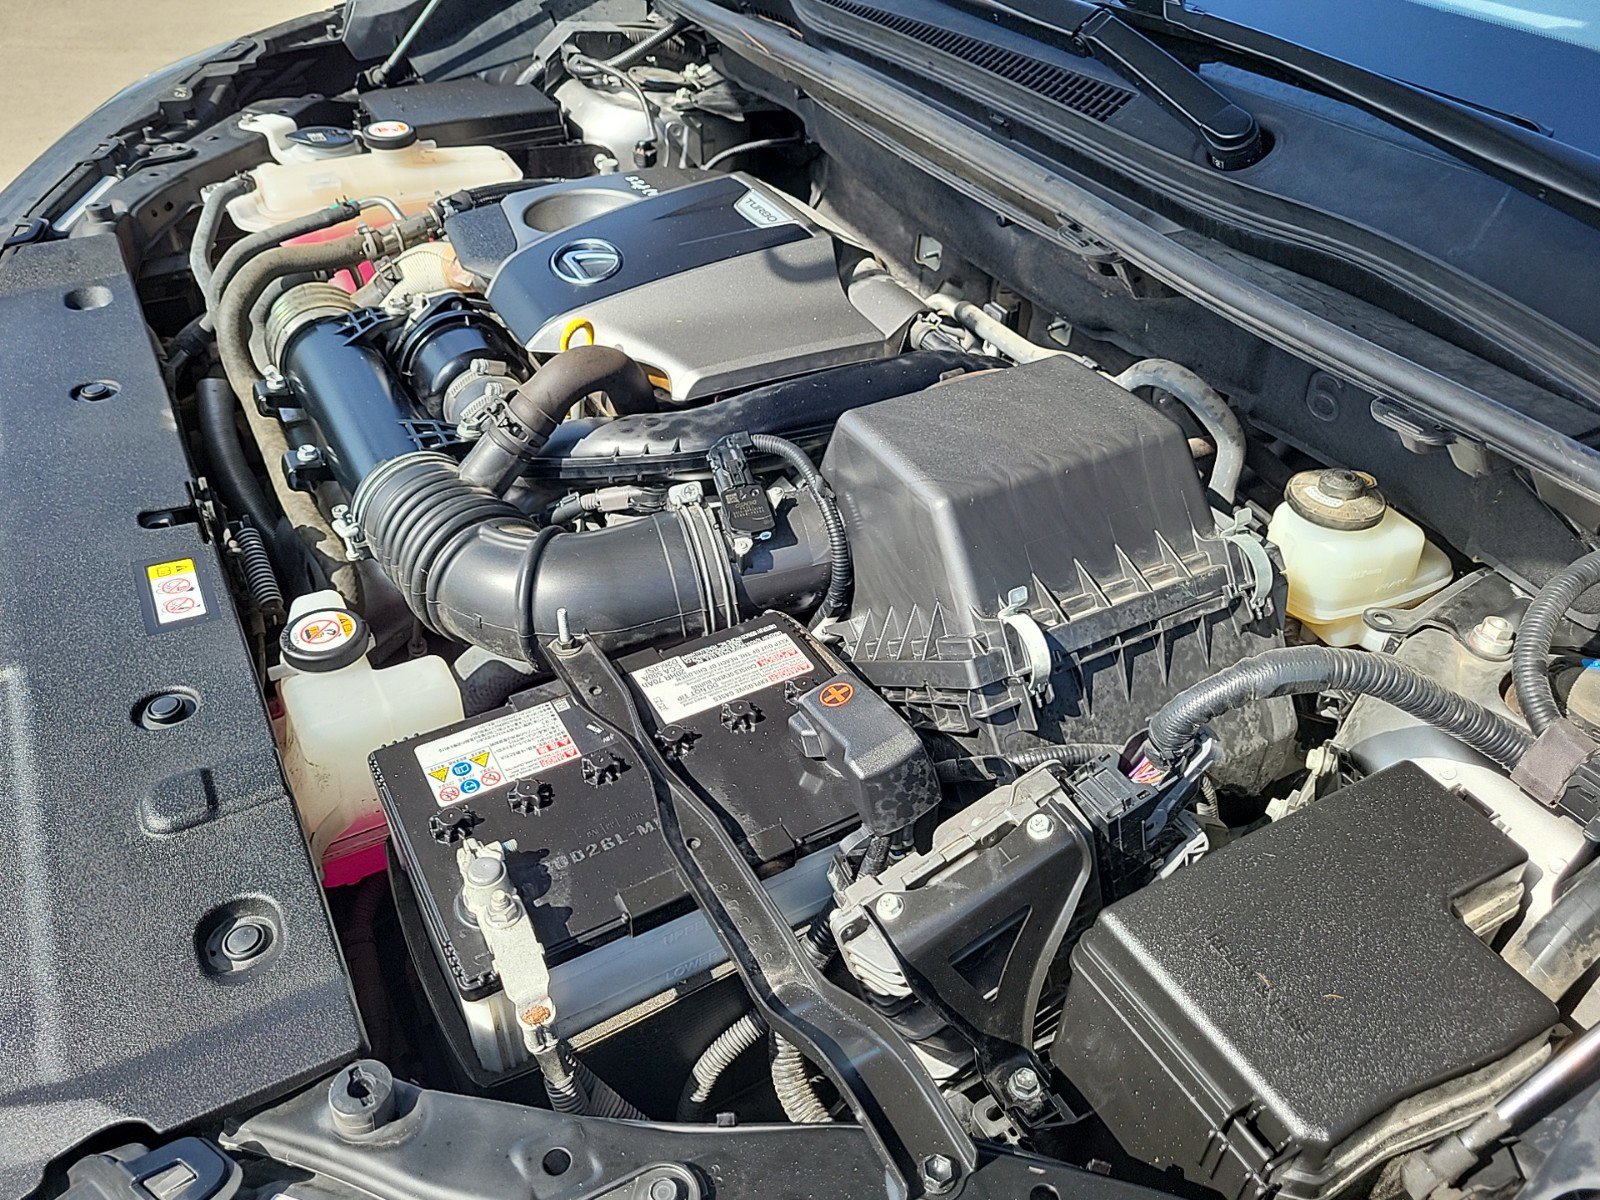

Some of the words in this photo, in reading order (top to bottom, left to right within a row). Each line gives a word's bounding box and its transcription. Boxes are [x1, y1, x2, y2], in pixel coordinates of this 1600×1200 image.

[745, 198, 778, 223] TURBO
[1306, 371, 1343, 422] 6
[760, 643, 773, 651] OUT
[773, 638, 788, 647] KEEP
[737, 651, 750, 660] THE
[716, 655, 737, 668] REACH
[663, 663, 681, 674] CCA
[675, 666, 707, 682] CHILDREN
[733, 663, 756, 675] CAUSES
[641, 677, 662, 688] 70Ah
[707, 681, 718, 690] DO
[734, 678, 768, 694] EXPLOSIVE
[690, 686, 706, 696] NOT
[713, 690, 734, 702] GASES
[676, 693, 687, 701] TIP
[664, 950, 718, 981] LOWER
